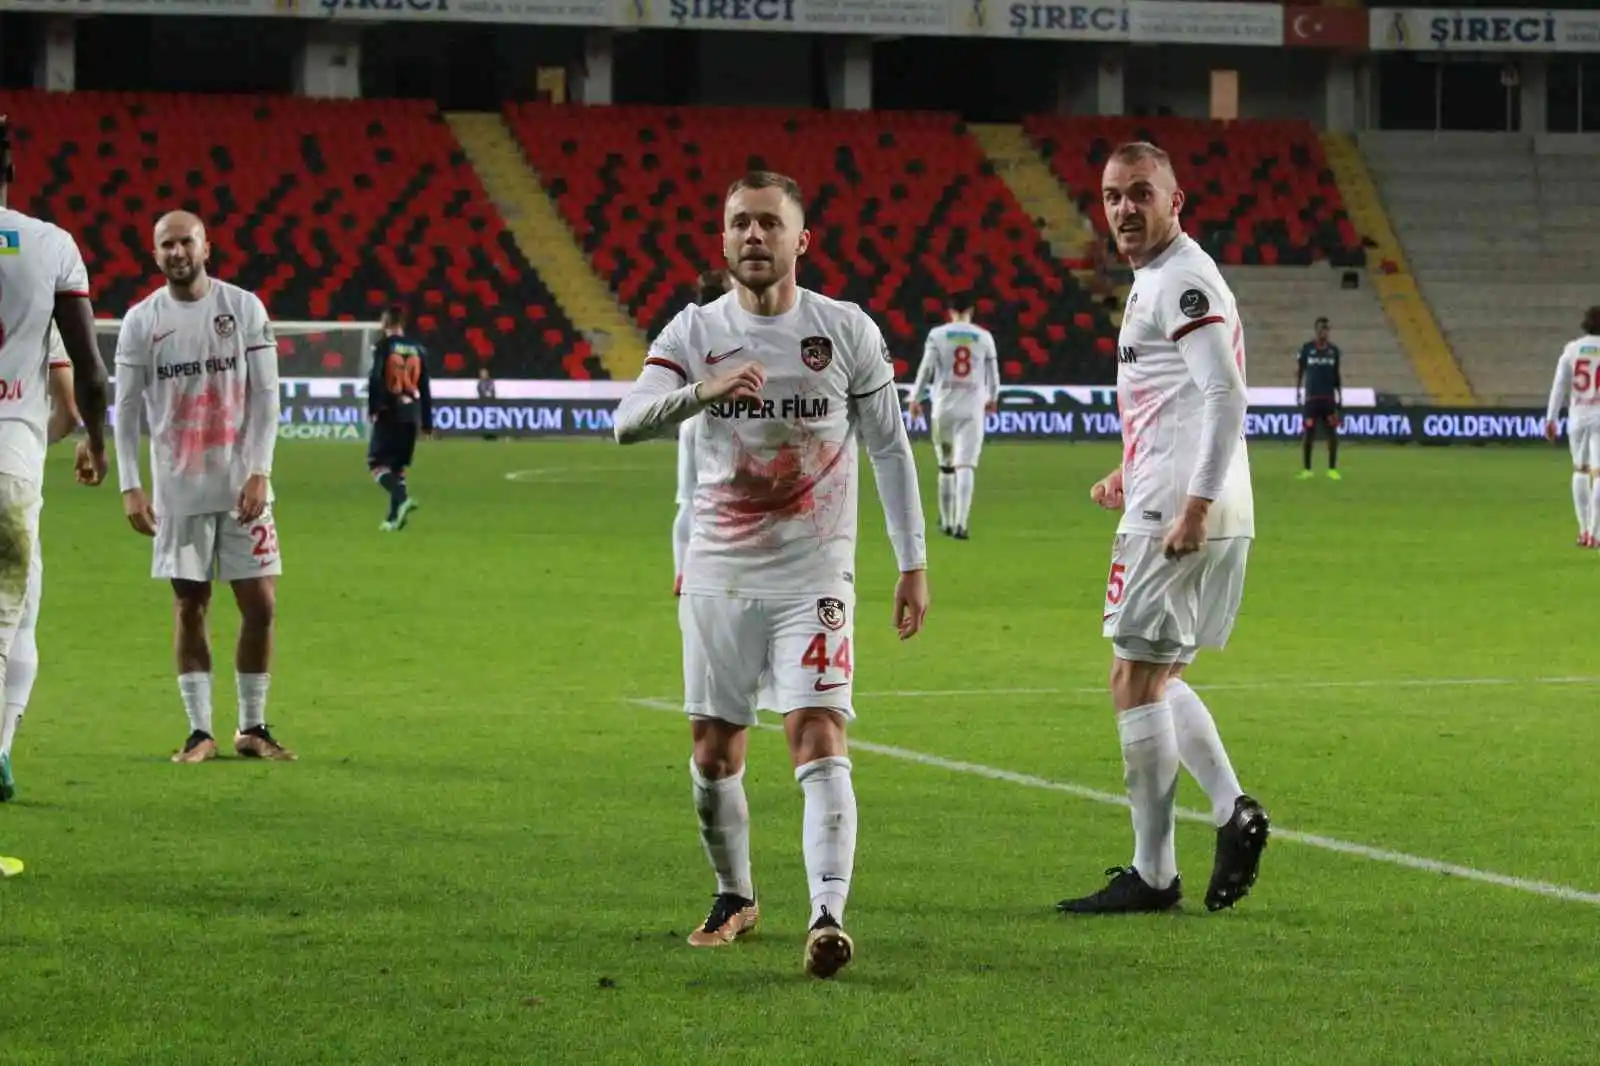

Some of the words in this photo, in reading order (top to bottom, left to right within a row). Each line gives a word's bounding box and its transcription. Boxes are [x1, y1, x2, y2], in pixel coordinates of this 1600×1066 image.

[1430, 12, 1556, 49] ŞİRECİ
[953, 345, 972, 378] 8
[1573, 359, 1600, 392] 5
[782, 394, 829, 418] FİLM
[279, 424, 360, 440] GORTA
[985, 411, 1073, 434] DENYUM
[1424, 415, 1548, 439] GOLDENYUM
[801, 632, 851, 679] 44
